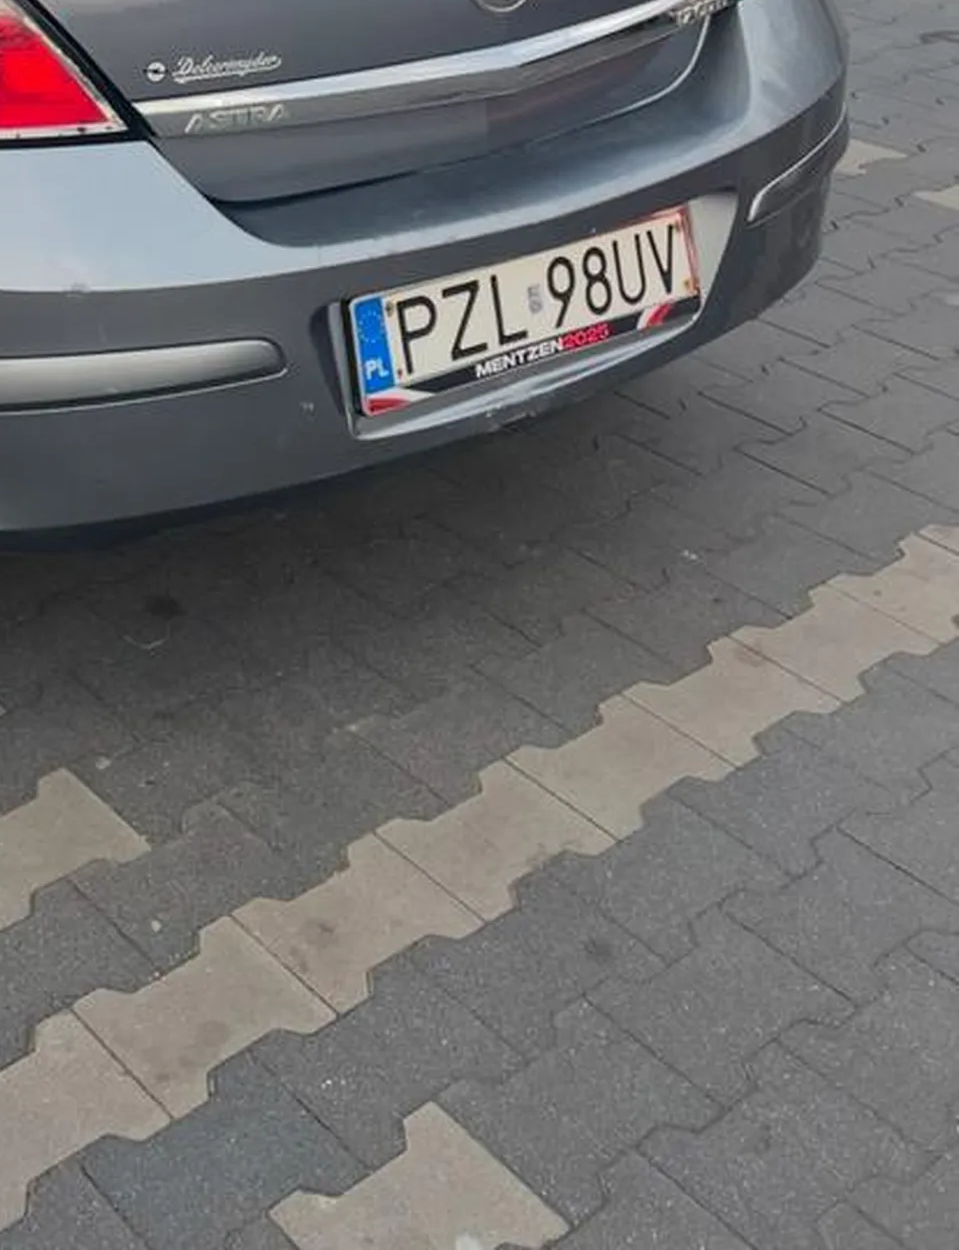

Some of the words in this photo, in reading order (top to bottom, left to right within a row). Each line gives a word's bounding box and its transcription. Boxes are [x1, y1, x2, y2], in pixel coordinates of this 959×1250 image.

[184, 103, 285, 134] ASTRA
[395, 274, 529, 376] PZL
[547, 223, 677, 328] 98UV
[365, 358, 390, 381] PL
